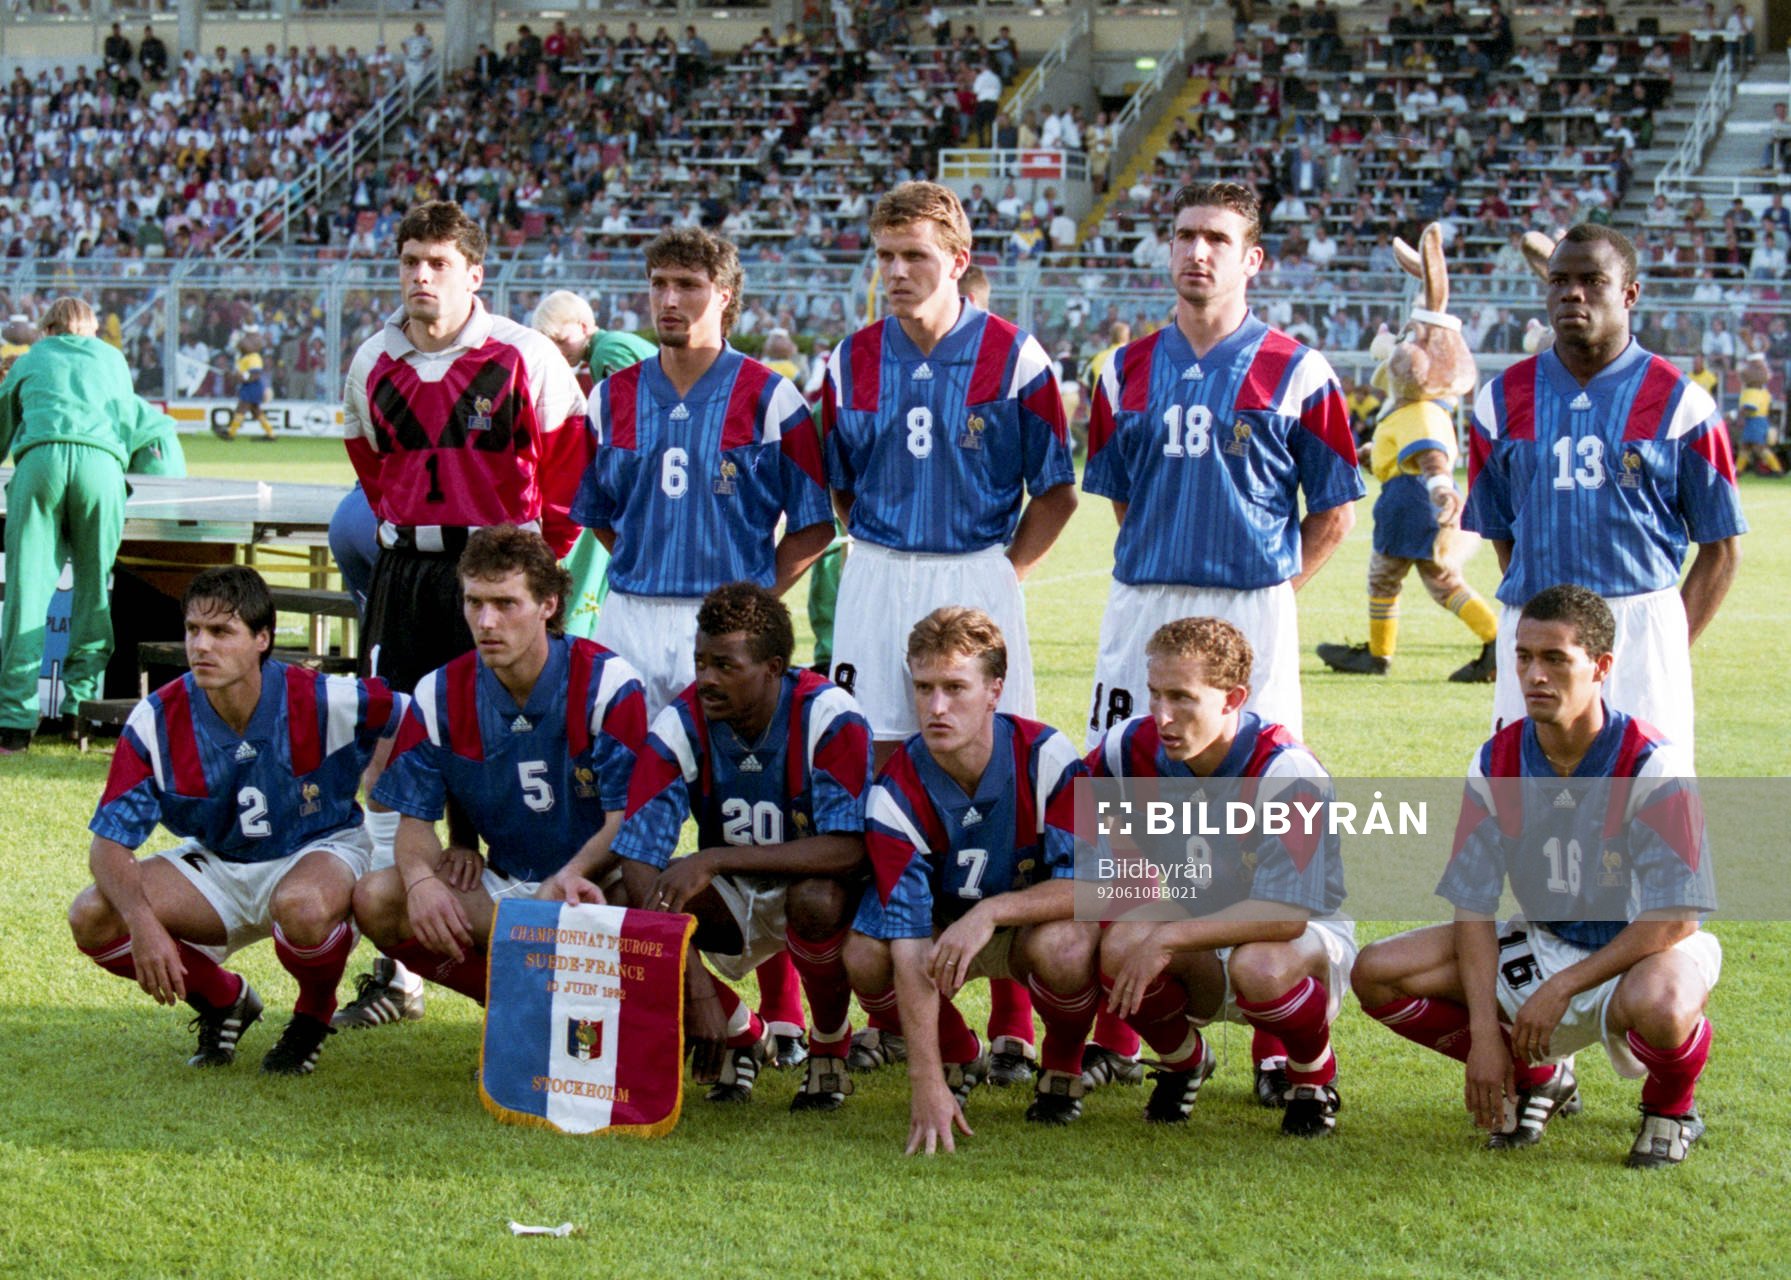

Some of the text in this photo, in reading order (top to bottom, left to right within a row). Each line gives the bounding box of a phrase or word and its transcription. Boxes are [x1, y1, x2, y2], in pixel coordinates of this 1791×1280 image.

[907, 406, 933, 459] 8
[1163, 404, 1213, 458] 18
[425, 452, 445, 504] 1
[661, 447, 689, 499] 6
[1553, 434, 1606, 490] 13
[237, 786, 272, 837] 2
[518, 760, 555, 812] 5
[722, 798, 784, 846] 20
[957, 848, 988, 899] 7
[1543, 837, 1582, 897] 16
[510, 925, 664, 958] CHAMPIONNAT D'EUROPE
[525, 953, 646, 982] SUEDE-FRANCE
[563, 981, 598, 998] JUIN
[602, 986, 626, 1000] 1992
[531, 1076, 630, 1104] STOCKHOLM
